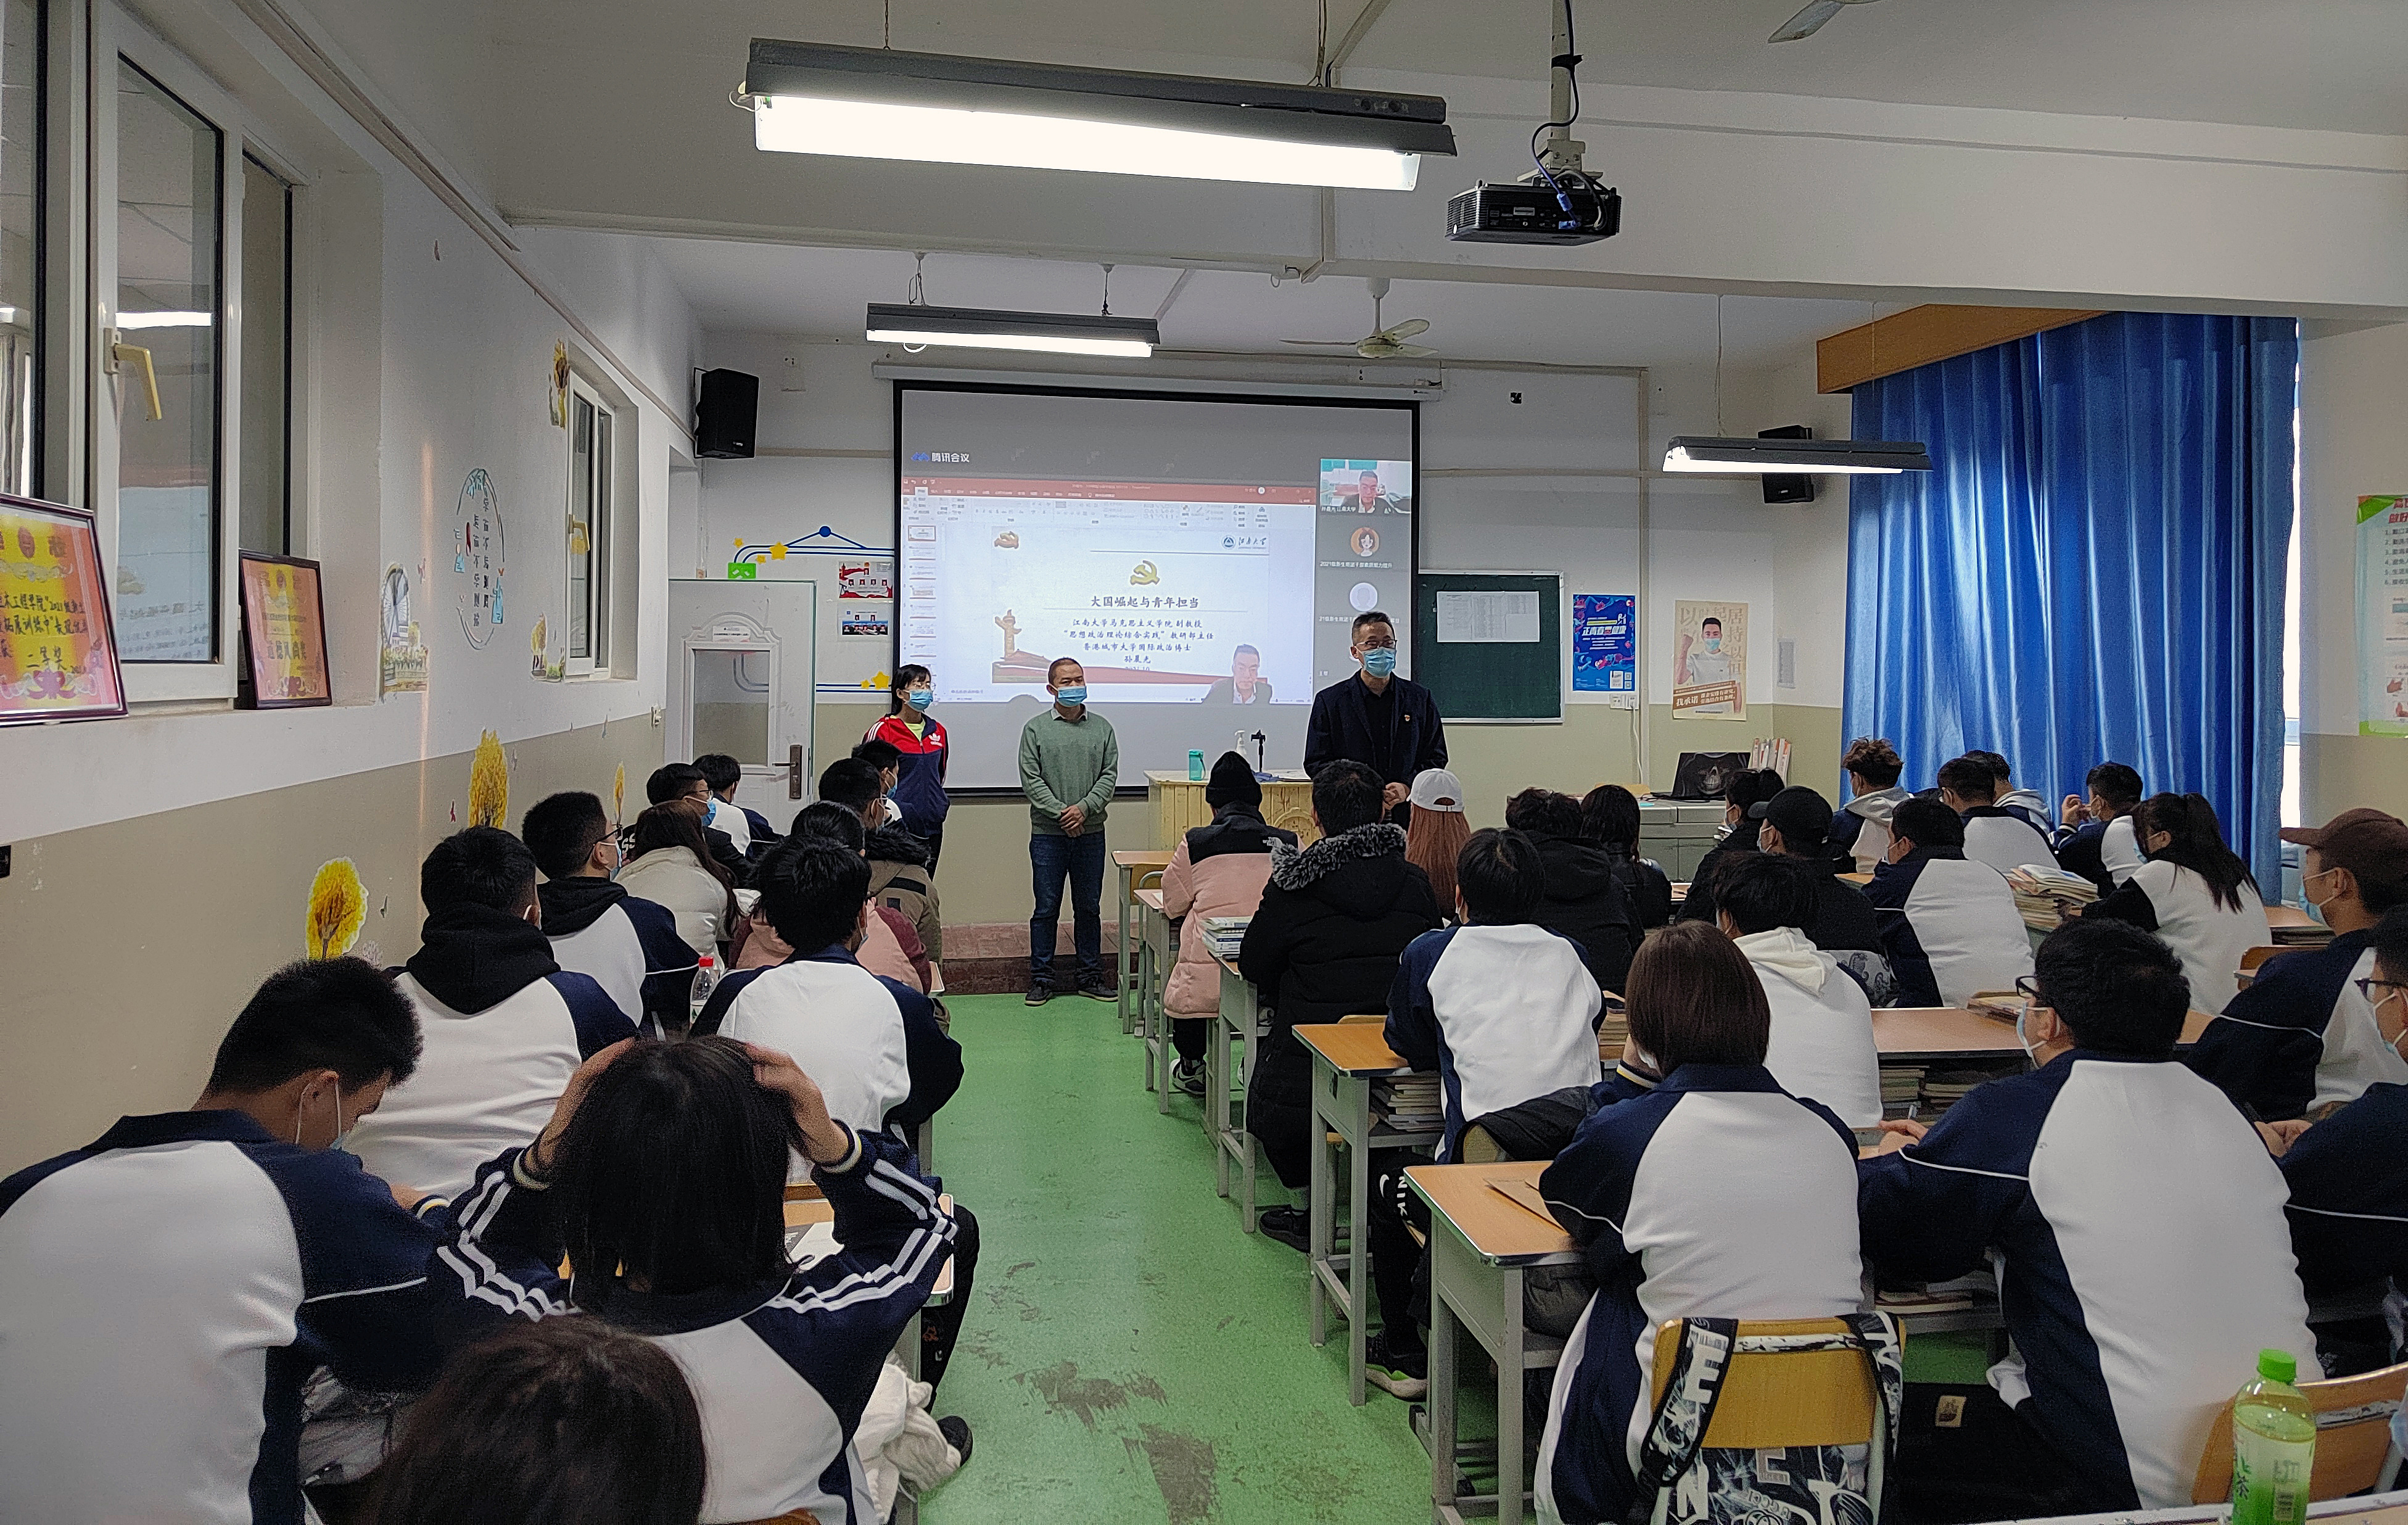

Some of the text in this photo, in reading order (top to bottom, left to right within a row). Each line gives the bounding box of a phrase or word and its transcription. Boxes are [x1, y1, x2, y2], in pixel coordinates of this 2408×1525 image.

[931, 452, 970, 463] 腾讯会议
[1091, 596, 1199, 608] 大国崛起与青年担当
[1124, 655, 1151, 664] 孙晨光
